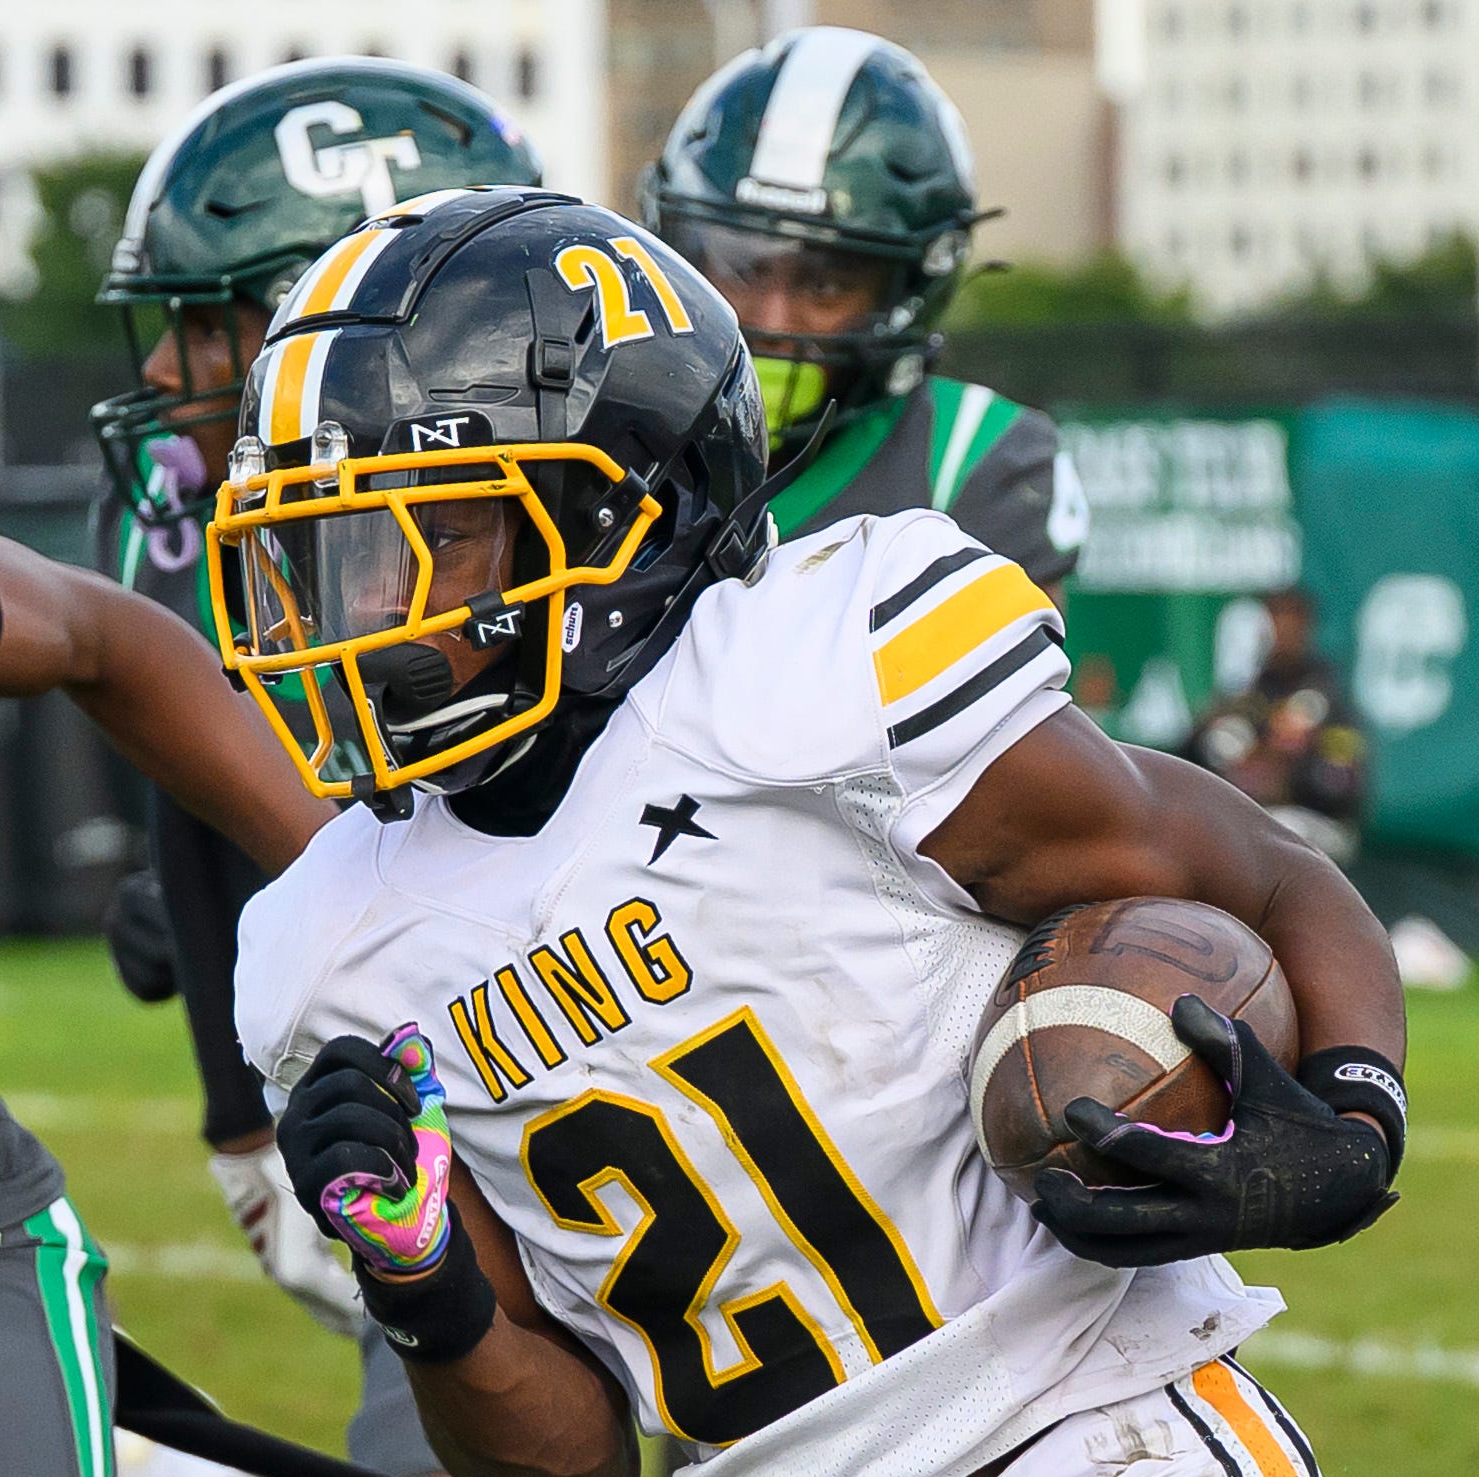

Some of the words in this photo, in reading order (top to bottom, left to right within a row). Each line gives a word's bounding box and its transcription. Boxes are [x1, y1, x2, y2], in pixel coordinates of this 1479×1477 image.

[555, 236, 695, 350] 21
[447, 896, 694, 1104] KING
[520, 1004, 946, 1448] 21
